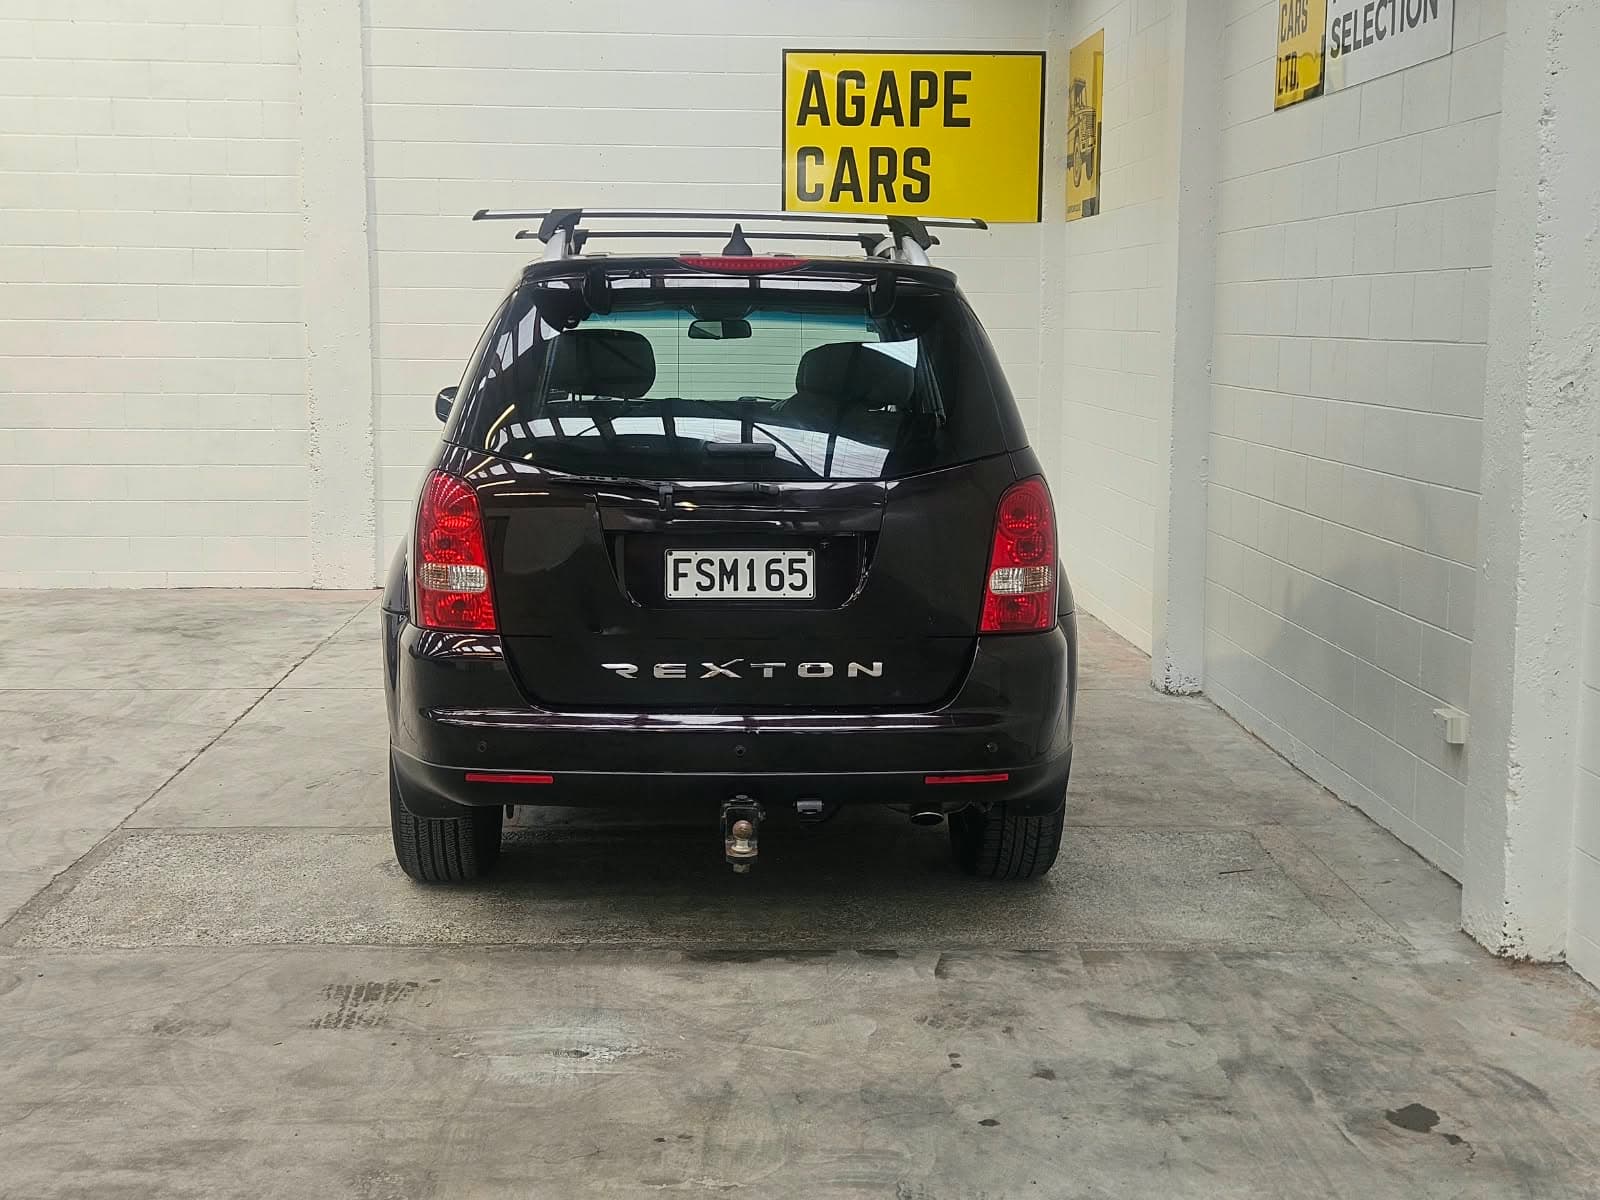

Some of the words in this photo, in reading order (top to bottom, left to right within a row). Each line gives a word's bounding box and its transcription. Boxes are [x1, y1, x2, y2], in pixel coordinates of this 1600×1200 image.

[1280, 0, 1308, 42] CARS
[1277, 51, 1299, 96] LTD.
[796, 69, 972, 128] AGAPE
[796, 146, 931, 204] CARS
[673, 557, 808, 592] FSM165
[601, 658, 883, 679] REXTON
